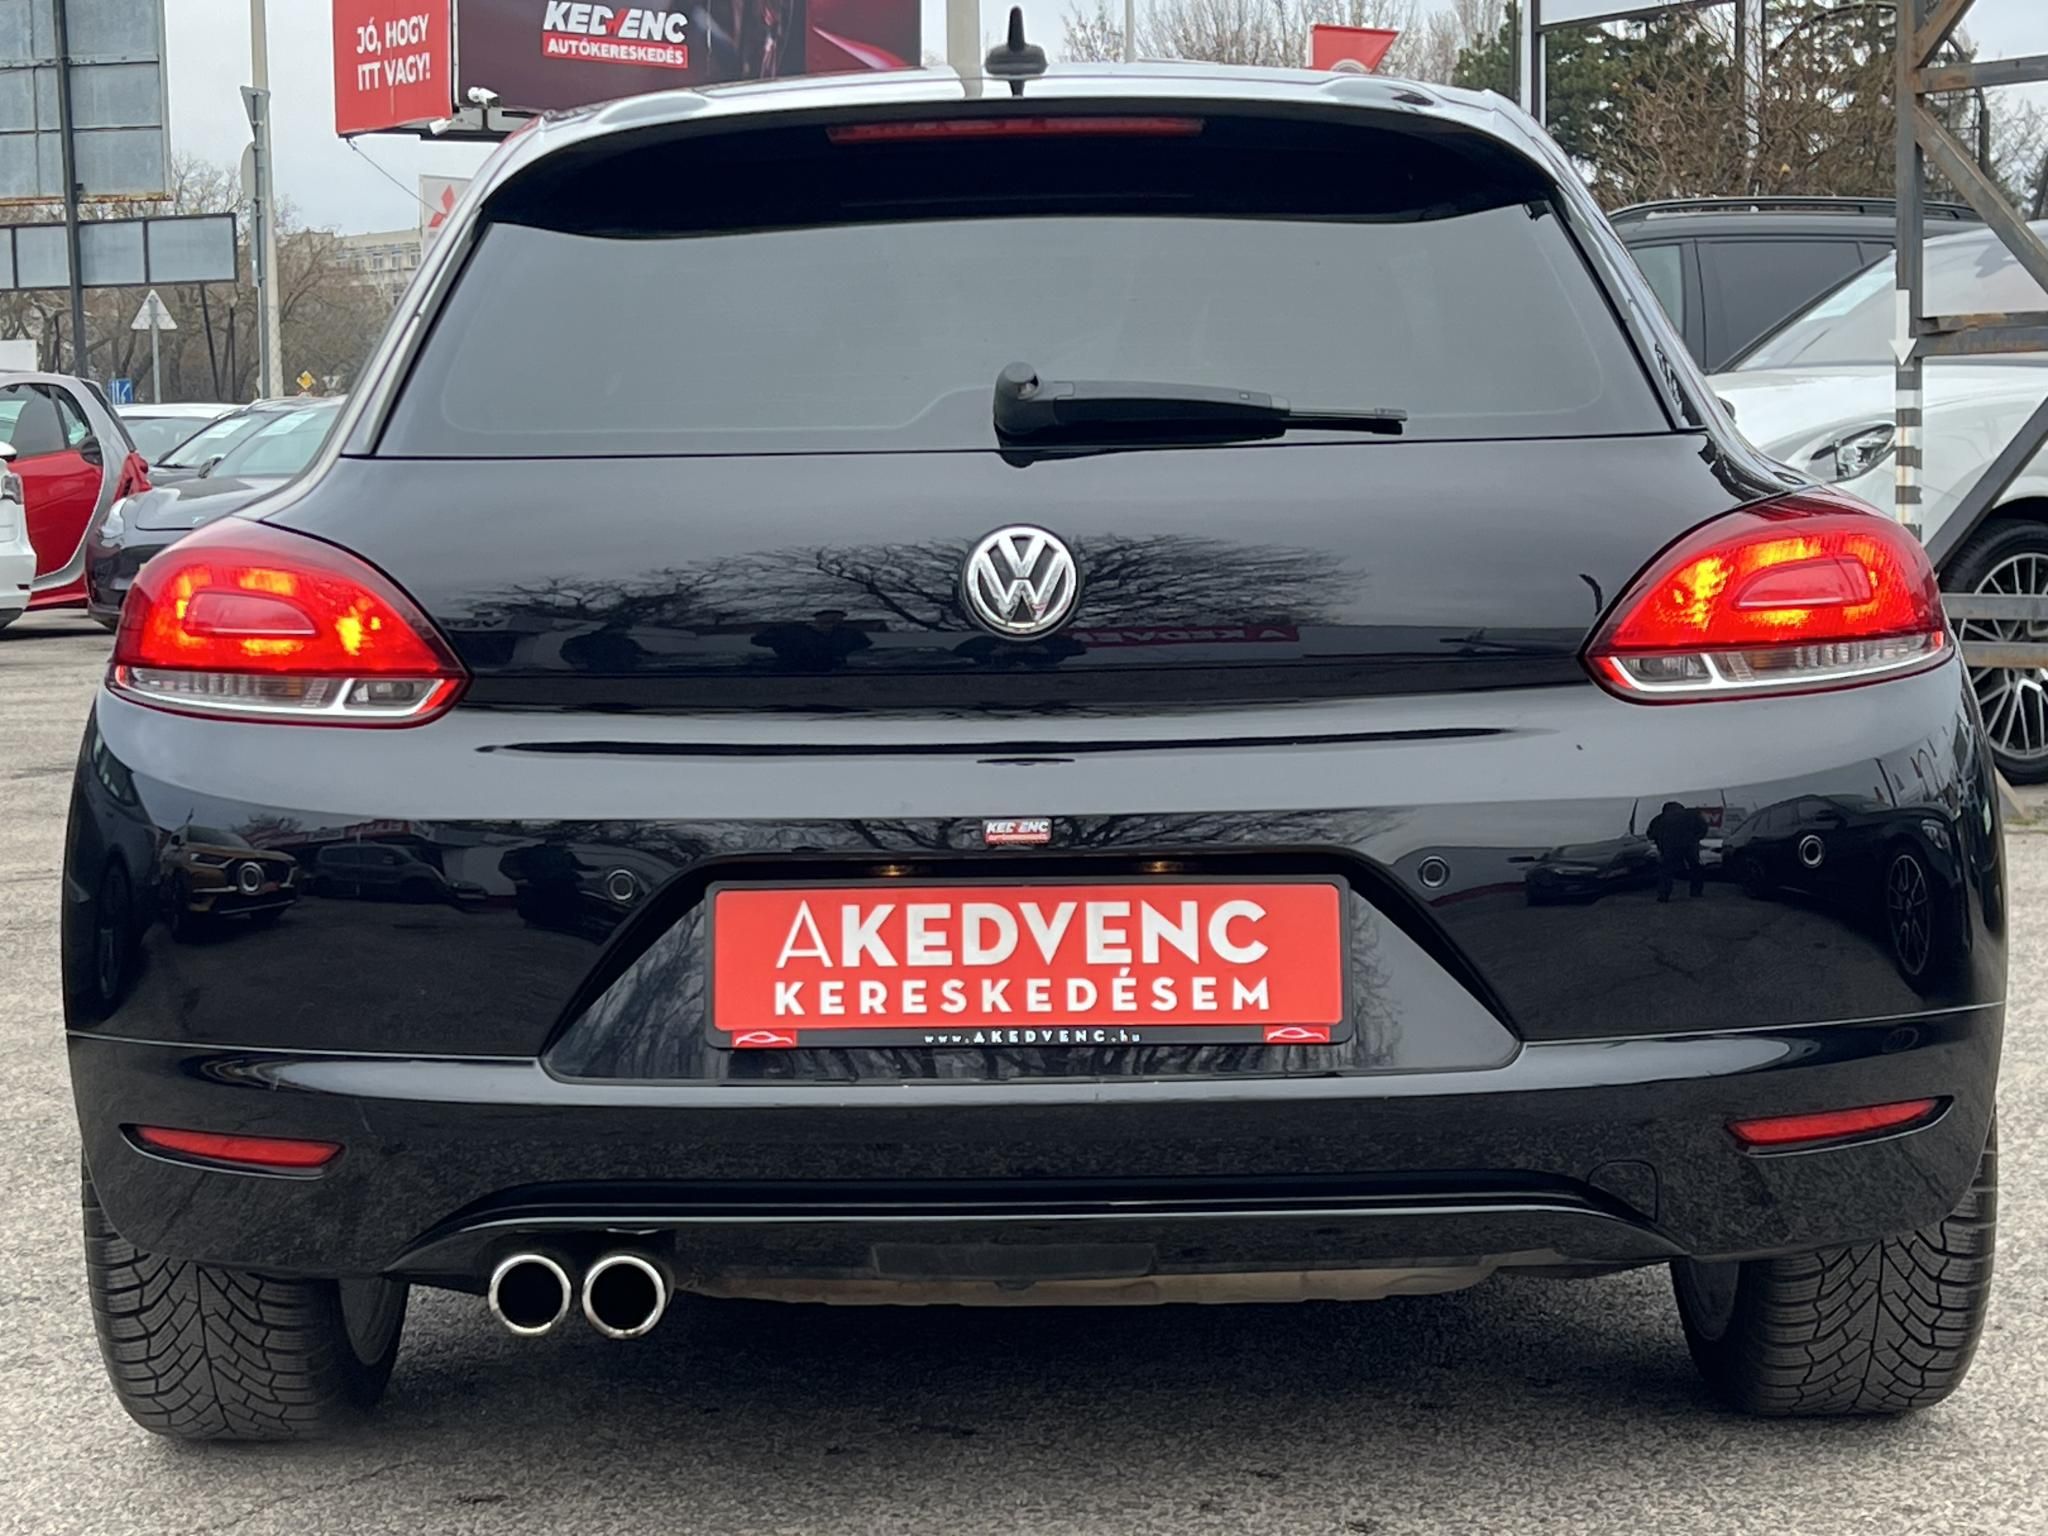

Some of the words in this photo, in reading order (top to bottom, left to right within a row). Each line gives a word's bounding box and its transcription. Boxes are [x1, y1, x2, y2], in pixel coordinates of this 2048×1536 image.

[356, 16, 382, 56] JÓ,
[385, 13, 430, 48] HOGY
[547, 37, 684, 65] AUTÓKERESKEDÉS
[357, 61, 381, 91] ITT
[384, 52, 431, 86] VAGY!
[967, 526, 1077, 635] VW
[774, 967, 1270, 1016] KERESKEDÉSEM
[924, 1029, 1141, 1044] www.AKEDVENC.hu
